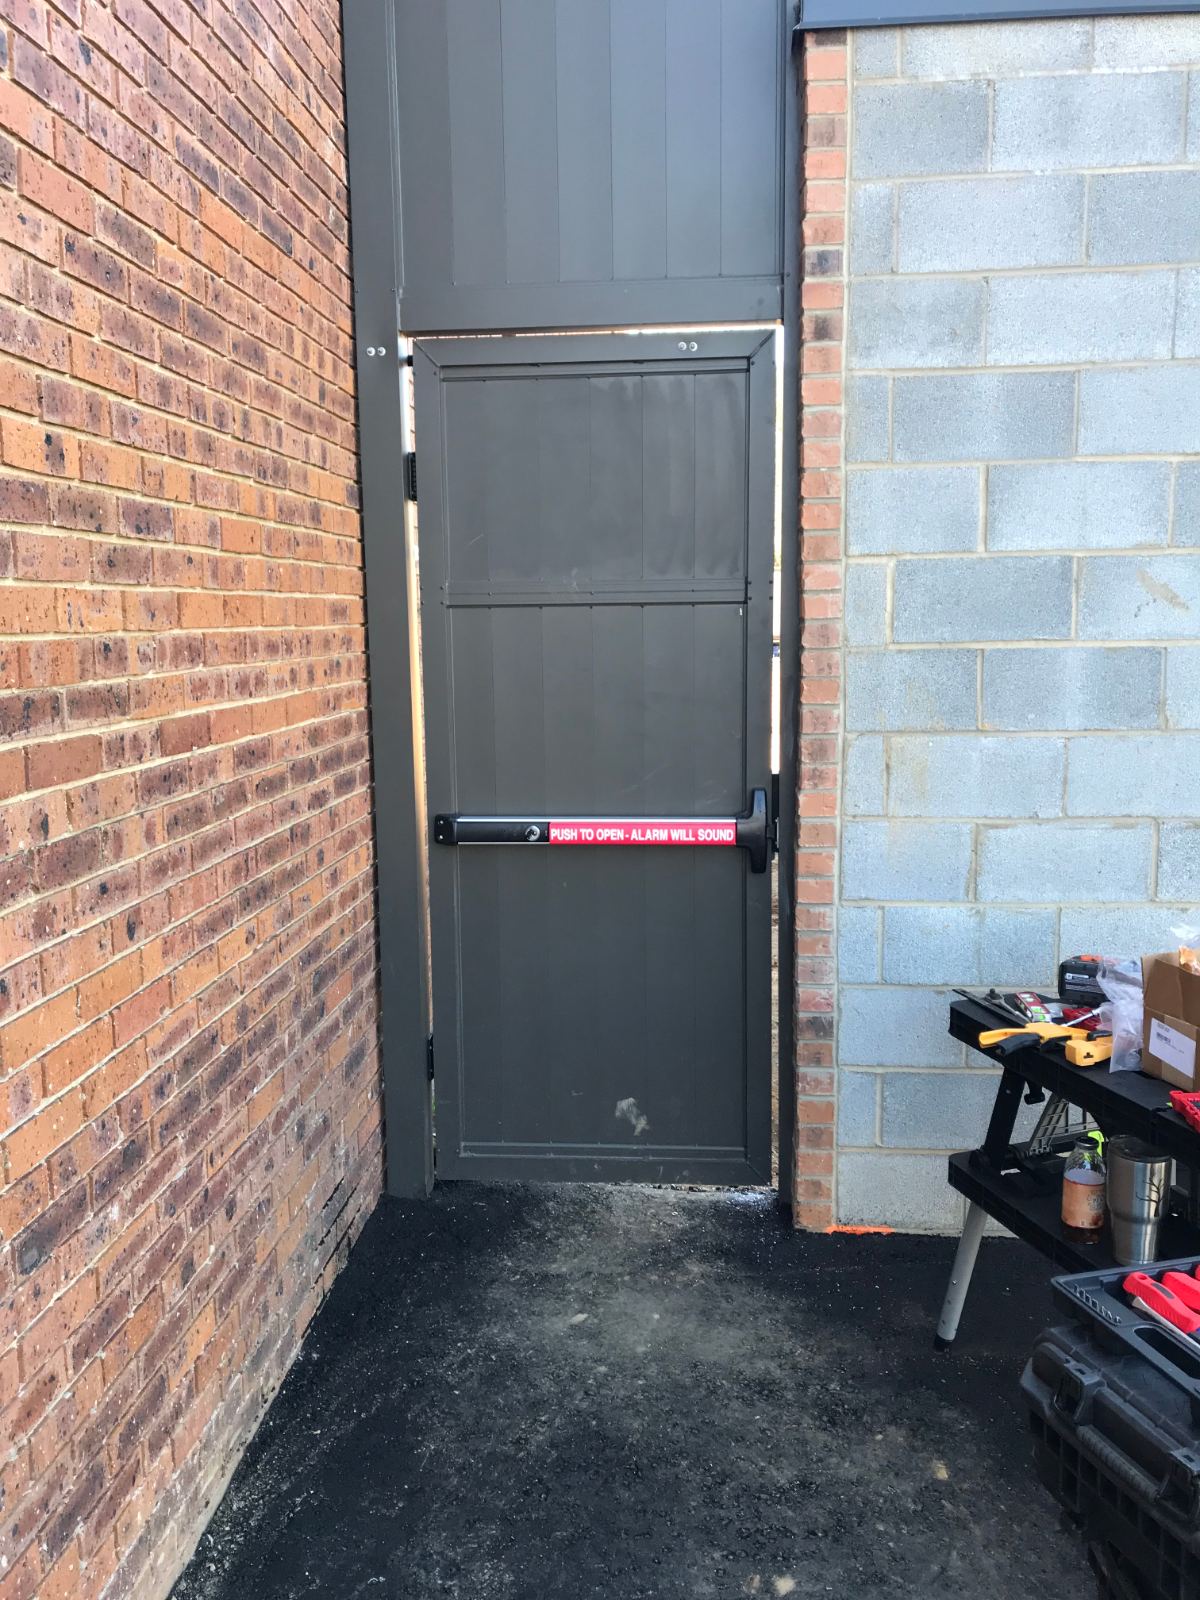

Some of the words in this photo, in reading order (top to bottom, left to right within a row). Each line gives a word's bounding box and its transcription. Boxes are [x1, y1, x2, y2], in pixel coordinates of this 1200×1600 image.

[550, 828, 577, 841] PUSH
[579, 828, 594, 841] TO
[596, 828, 624, 841] OPEN
[630, 828, 669, 841] ALARM
[670, 828, 695, 841] WILL
[697, 828, 734, 841] SOUND
